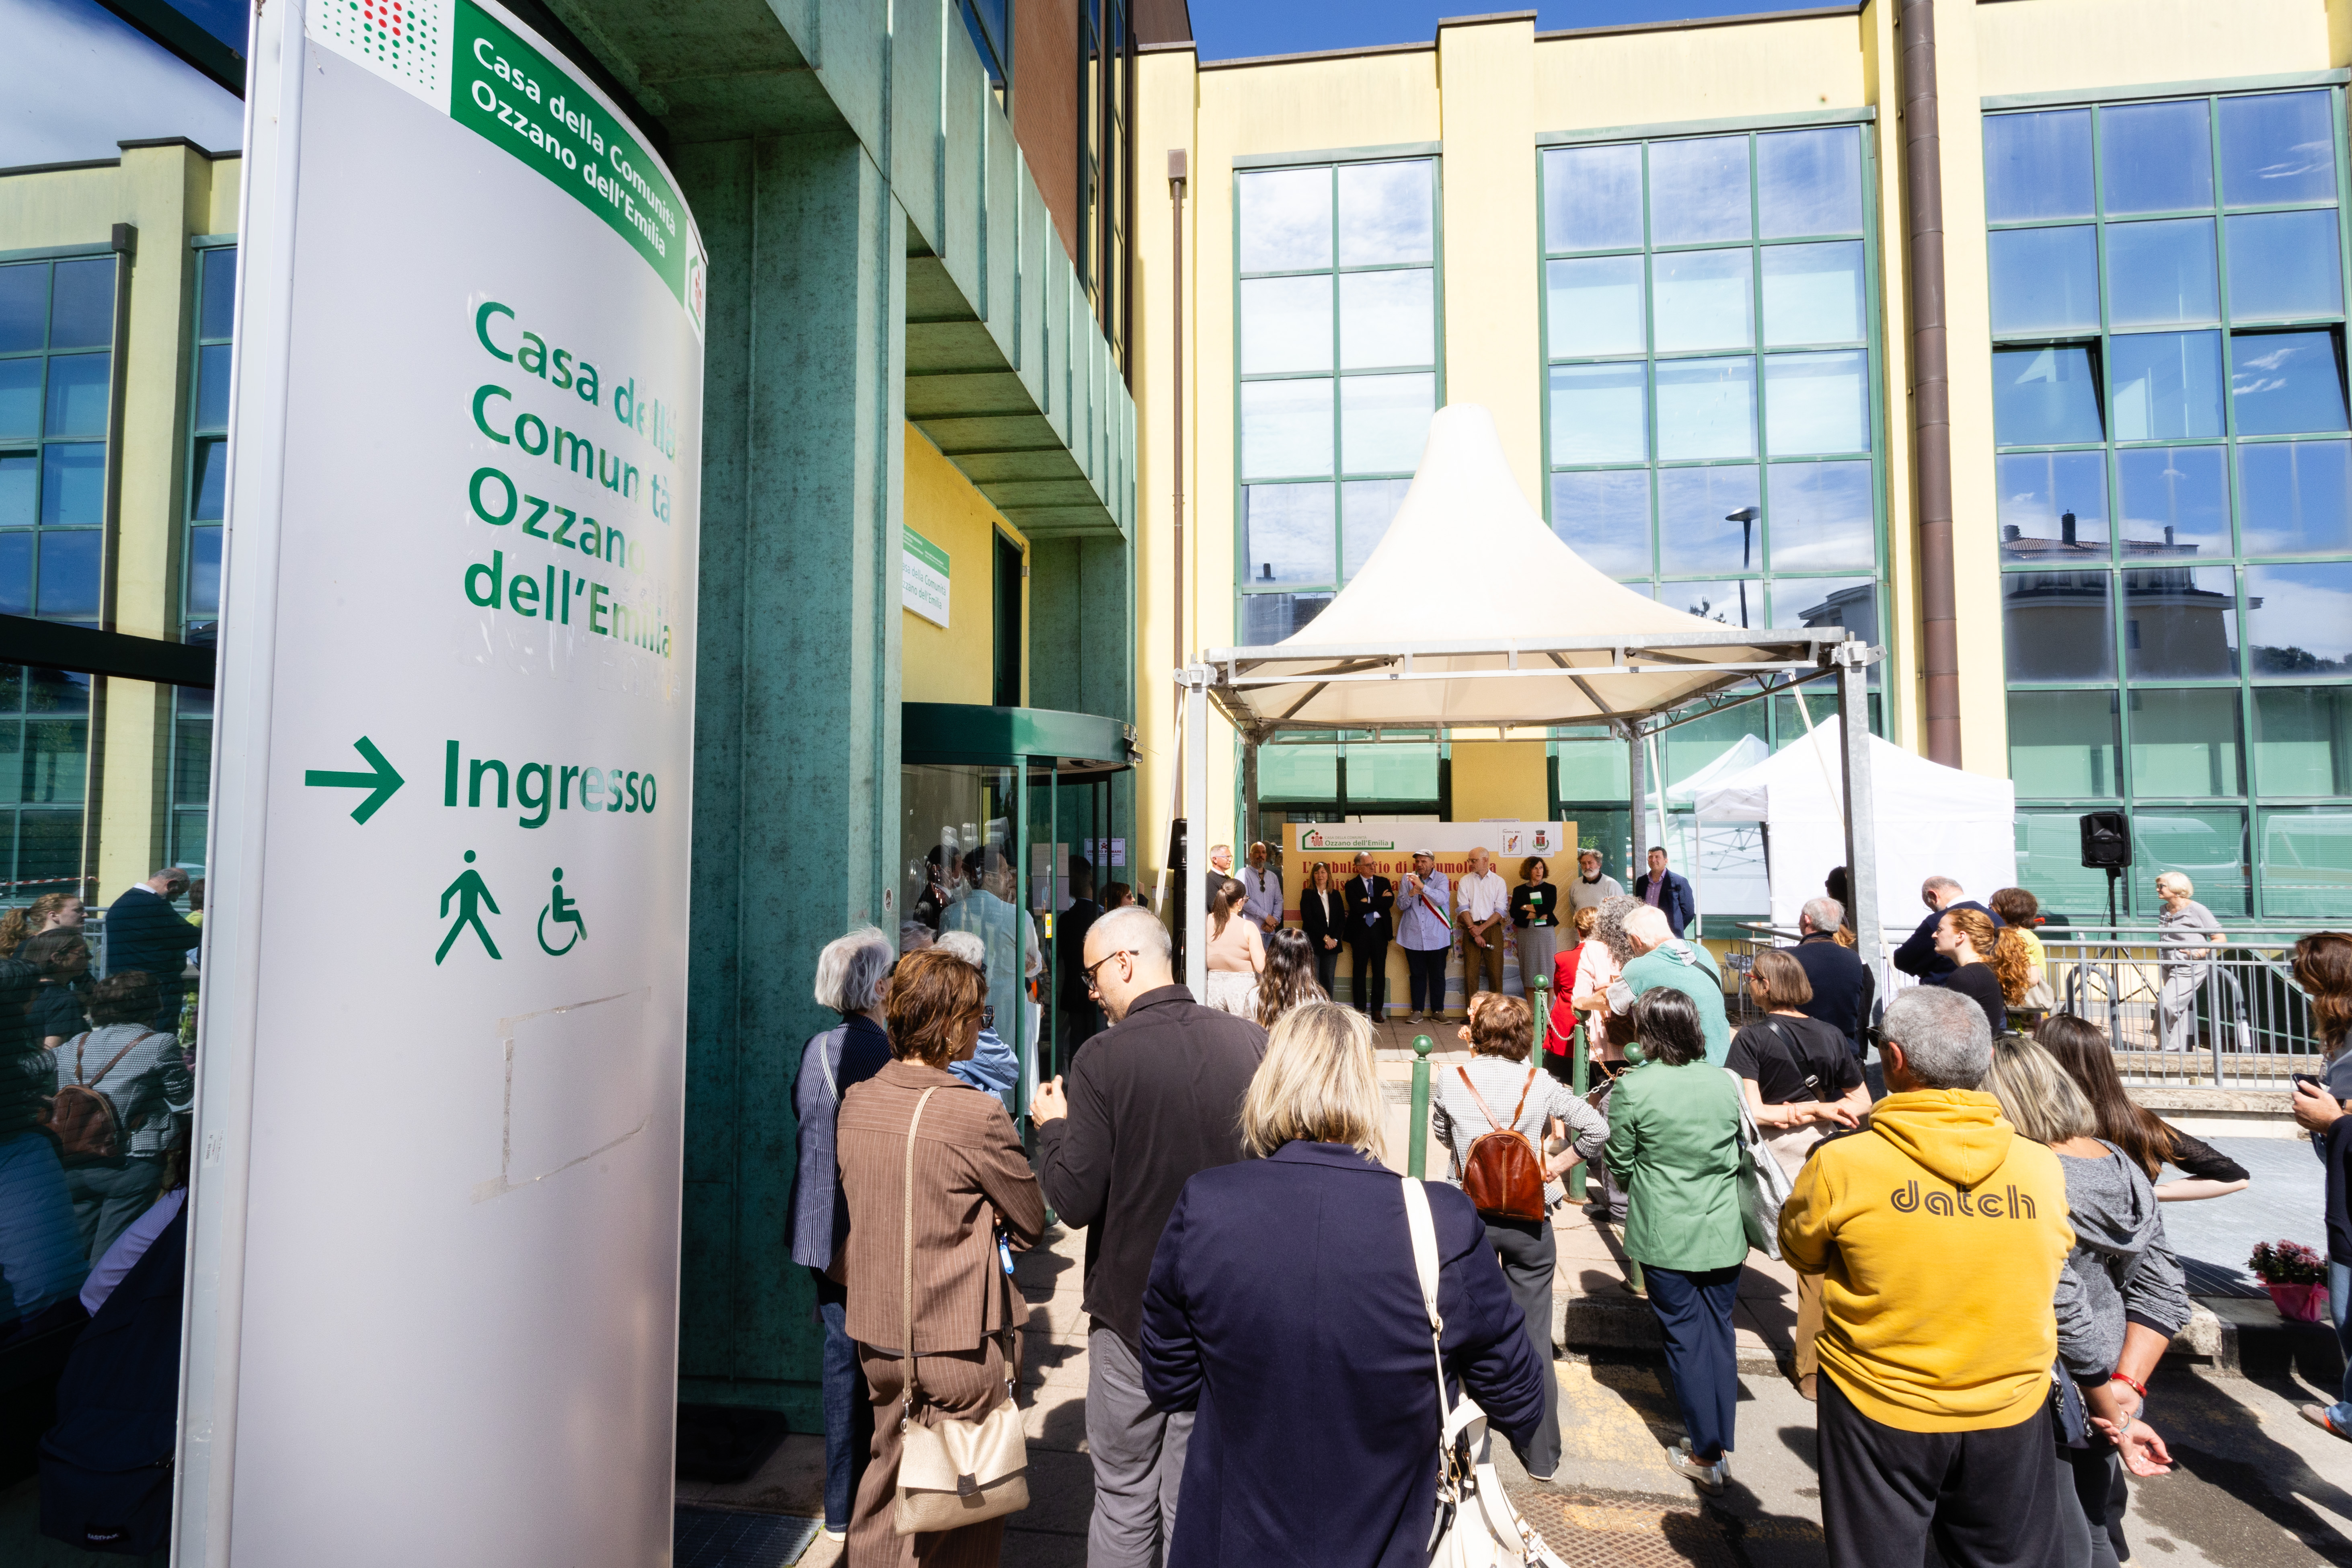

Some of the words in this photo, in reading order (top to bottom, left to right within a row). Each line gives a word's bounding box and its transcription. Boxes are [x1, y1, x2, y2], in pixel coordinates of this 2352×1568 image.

[472, 80, 577, 170] Ozzano
[583, 162, 665, 258] dell'Emilia
[473, 37, 540, 105] Casa
[550, 95, 604, 156] della
[610, 145, 675, 238] Comunità
[476, 302, 599, 407] Casa
[614, 376, 676, 464] della
[472, 384, 671, 526] Comunità
[469, 467, 645, 575] Ozzano
[464, 549, 672, 660] dell'Emilia
[902, 563, 910, 574] asa
[912, 566, 923, 582] della
[925, 575, 946, 596] Comunità
[902, 580, 917, 595] zzano
[444, 740, 656, 829] Ingresso
[1395, 861, 1407, 873] di
[1891, 1180, 2036, 1219] datch
